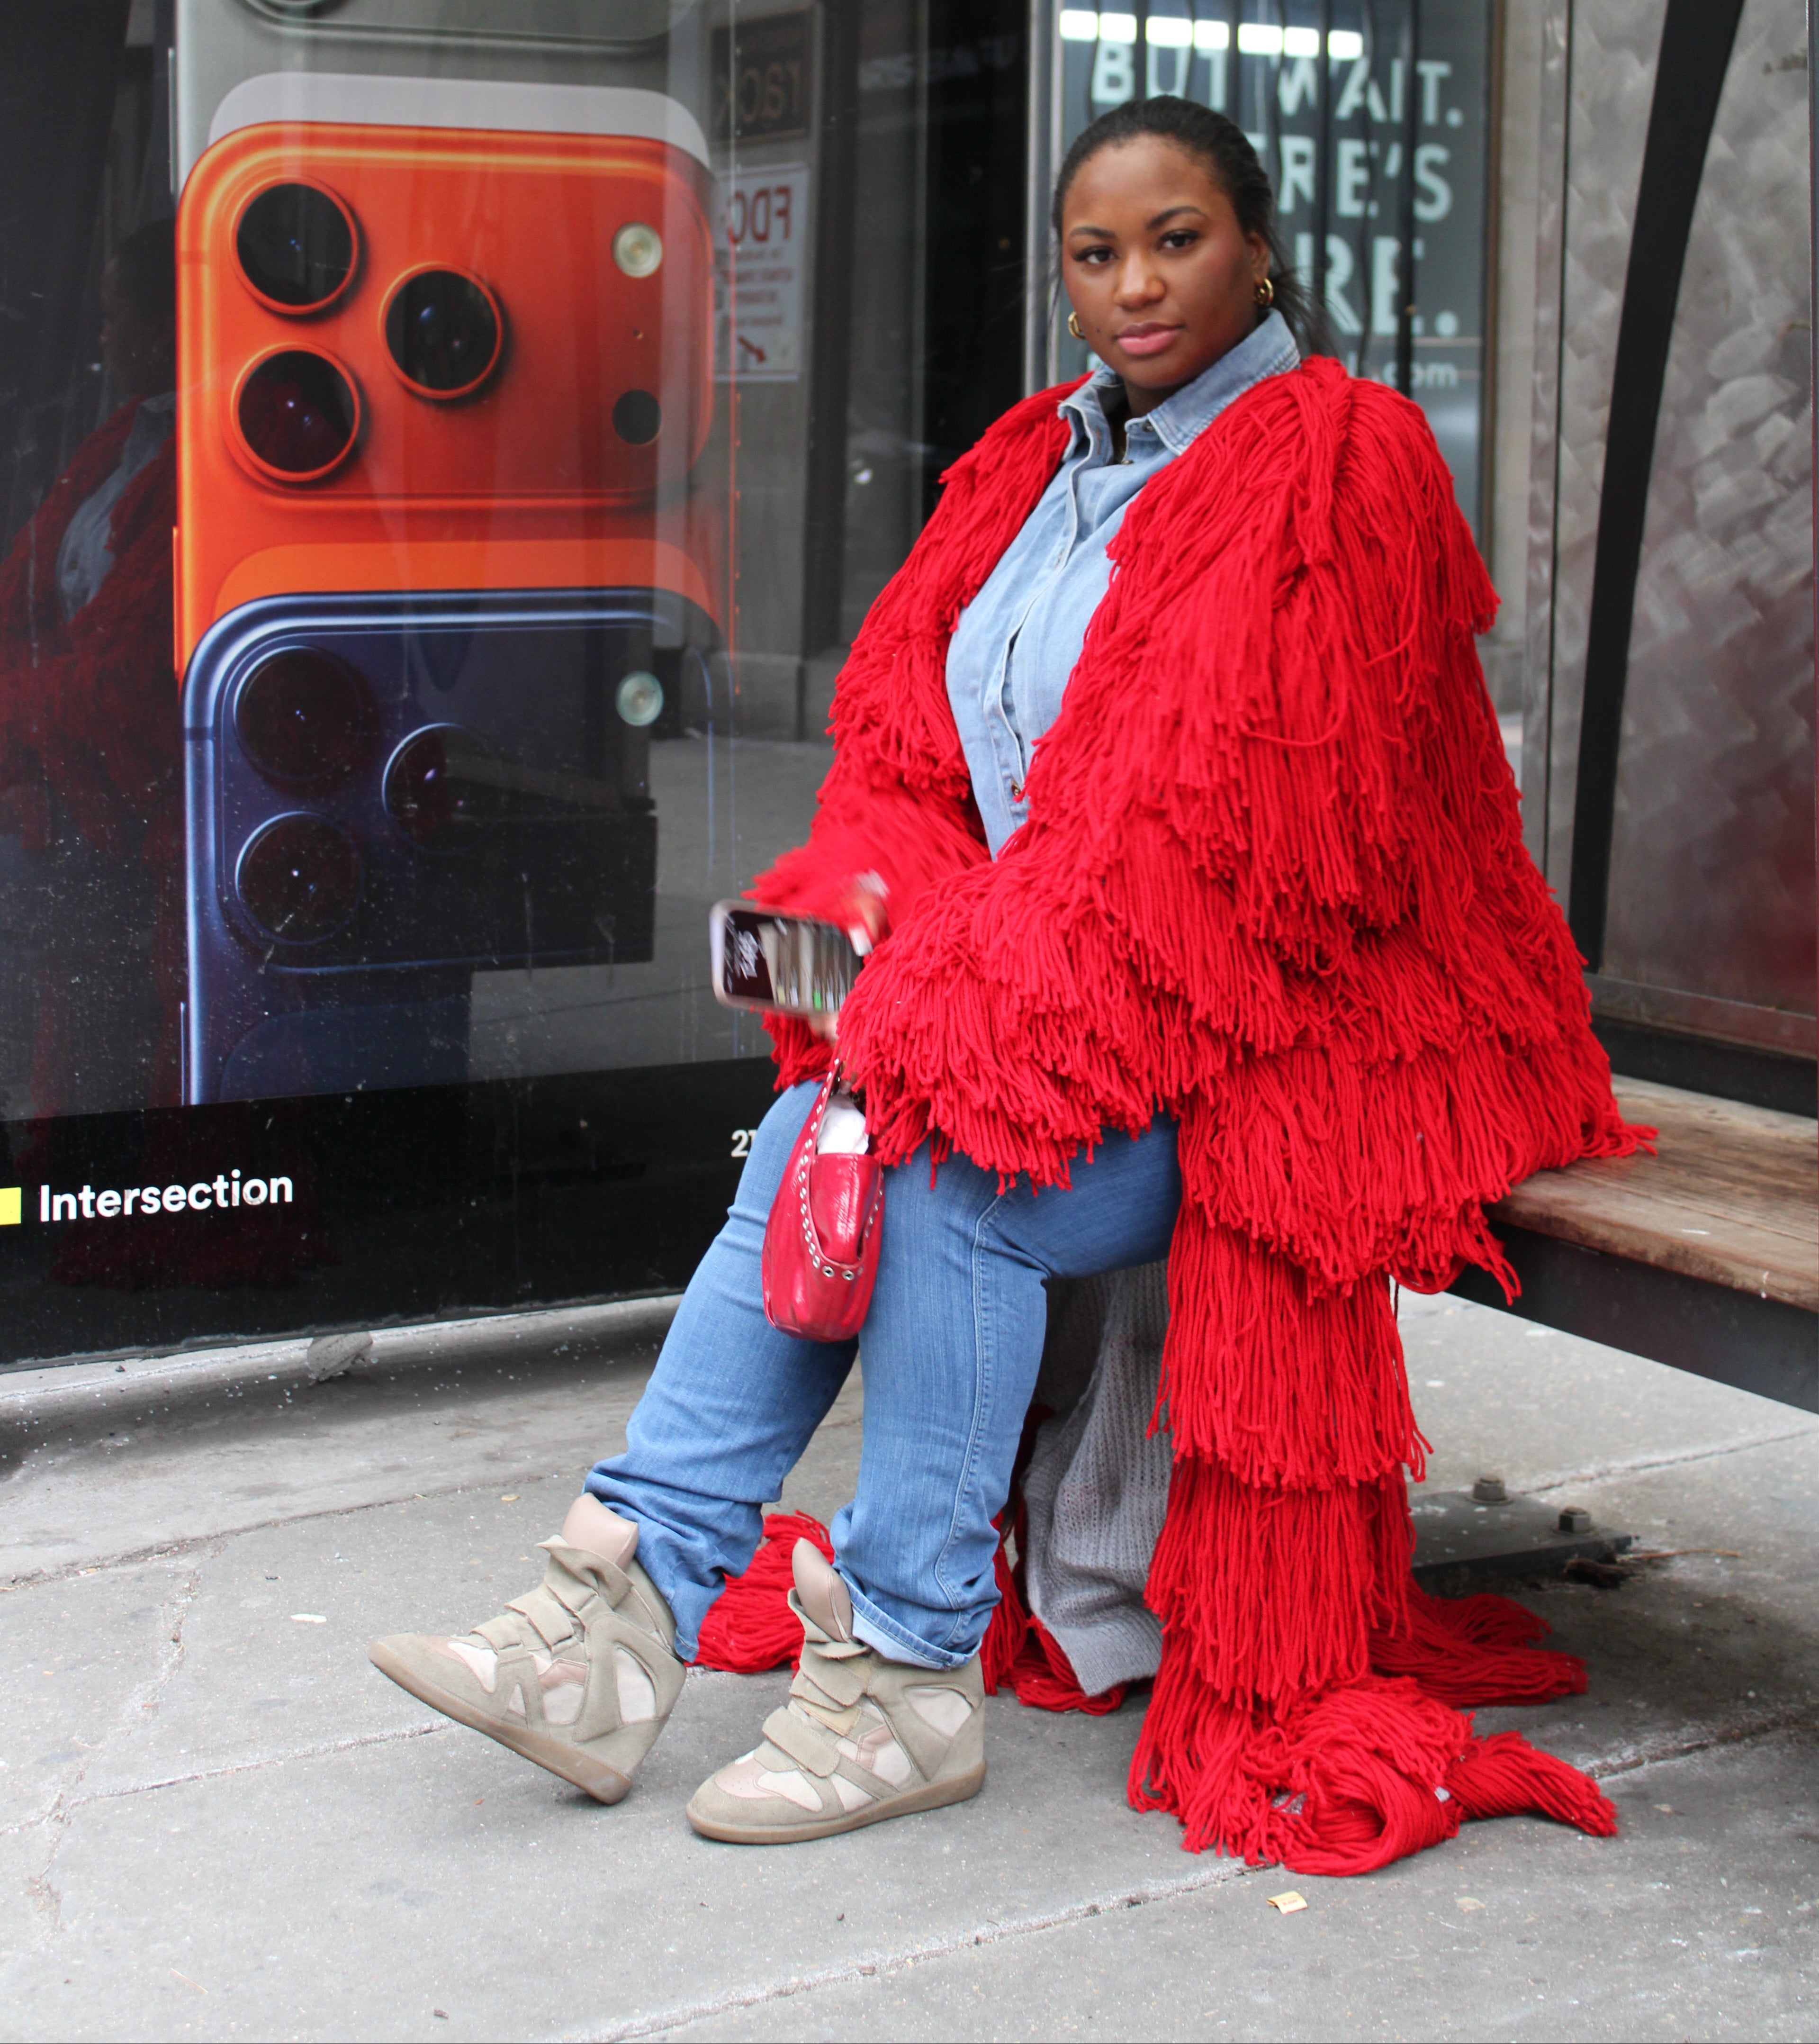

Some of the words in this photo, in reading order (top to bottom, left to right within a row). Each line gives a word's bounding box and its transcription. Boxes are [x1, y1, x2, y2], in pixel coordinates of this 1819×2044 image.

[1091, 40, 1228, 113] BUT
[1269, 53, 1464, 128] WAIT.
[1247, 132, 1453, 222] RE'S
[1296, 232, 1459, 337] RE.
[40, 1169, 293, 1222] Intersection
